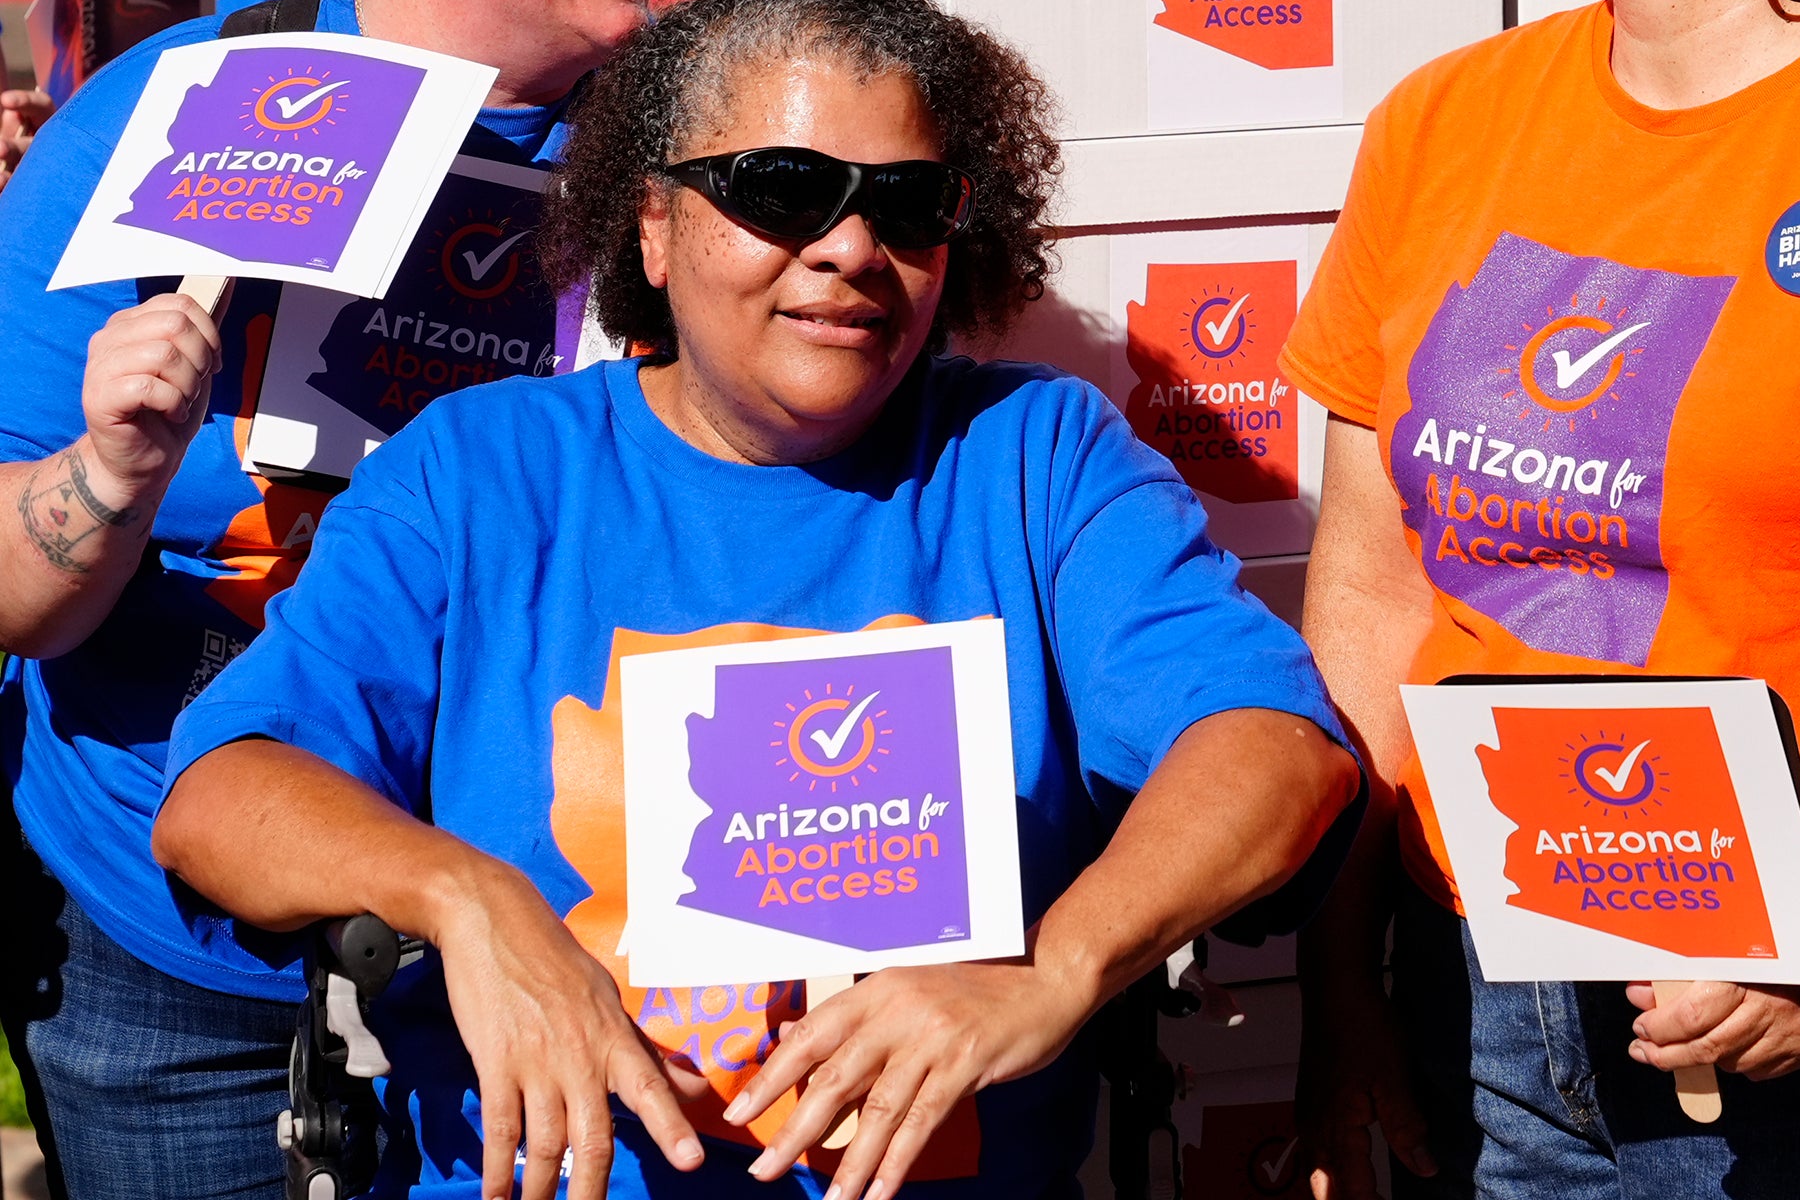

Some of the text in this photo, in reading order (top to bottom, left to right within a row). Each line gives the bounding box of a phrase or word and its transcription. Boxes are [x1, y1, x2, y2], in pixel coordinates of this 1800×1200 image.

[1204, 4, 1302, 28] Access
[170, 146, 367, 185] Arizona for
[167, 173, 344, 206] Abortion
[173, 200, 312, 226] Access
[363, 308, 564, 377] Arizona for
[365, 345, 507, 388] Aborti
[1148, 377, 1289, 407] Arizona for
[1155, 406, 1281, 436] Abortion
[1170, 437, 1267, 461] Access
[1412, 418, 1646, 509] Arizona for
[1426, 473, 1629, 548] Abortion
[1436, 525, 1616, 580] Access
[723, 792, 950, 844] Arizona for
[735, 830, 939, 878] Abortion
[1535, 825, 1735, 859] Arizona for
[758, 866, 919, 908] Access
[1553, 855, 1735, 884] Abortion
[1581, 887, 1721, 911] Access
